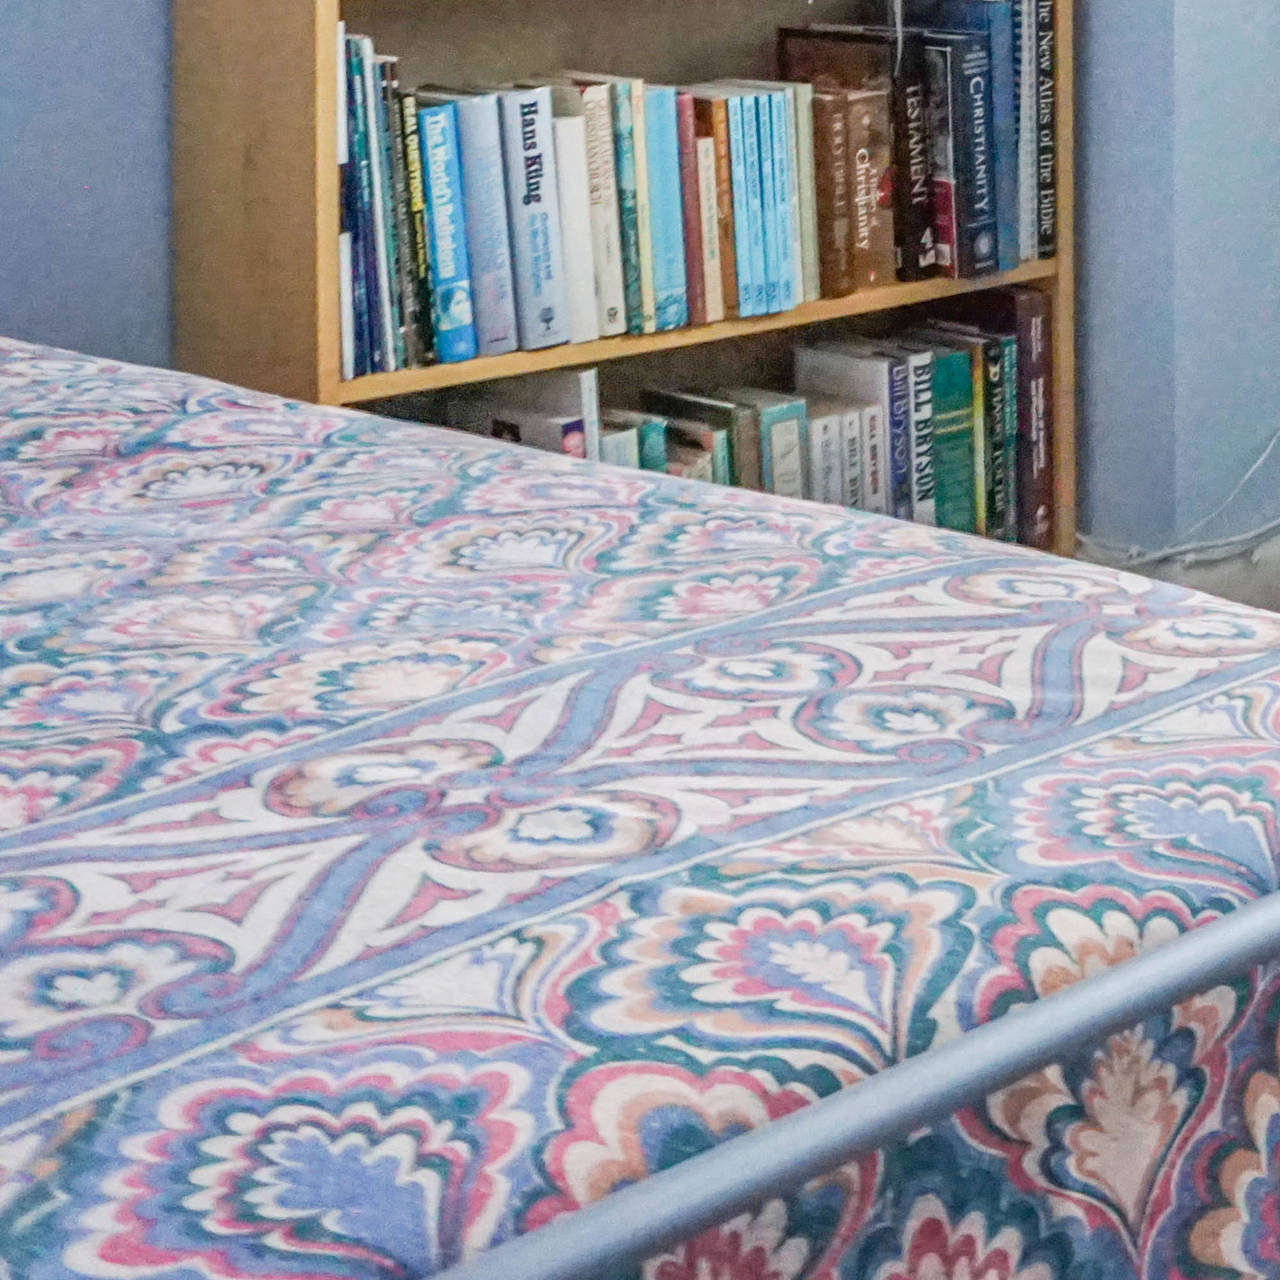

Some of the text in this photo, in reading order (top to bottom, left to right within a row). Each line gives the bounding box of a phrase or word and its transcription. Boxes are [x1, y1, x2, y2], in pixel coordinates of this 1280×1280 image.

[1039, 31, 1054, 69] New
[402, 97, 417, 133] REAL
[520, 100, 539, 151] Hans
[1039, 76, 1054, 124] Atlas
[905, 84, 928, 205] TESTAMENT
[970, 76, 989, 211] CHRISTIANITY
[1040, 129, 1055, 147] of
[1040, 153, 1055, 182] the
[405, 134, 424, 211] QUESTIONS
[428, 113, 456, 279] The World's Religions
[855, 148, 871, 249] Christianity
[1040, 189, 1055, 235] Bible
[891, 365, 909, 474] Bill Bryson
[914, 362, 936, 503] BILL BRYSON
